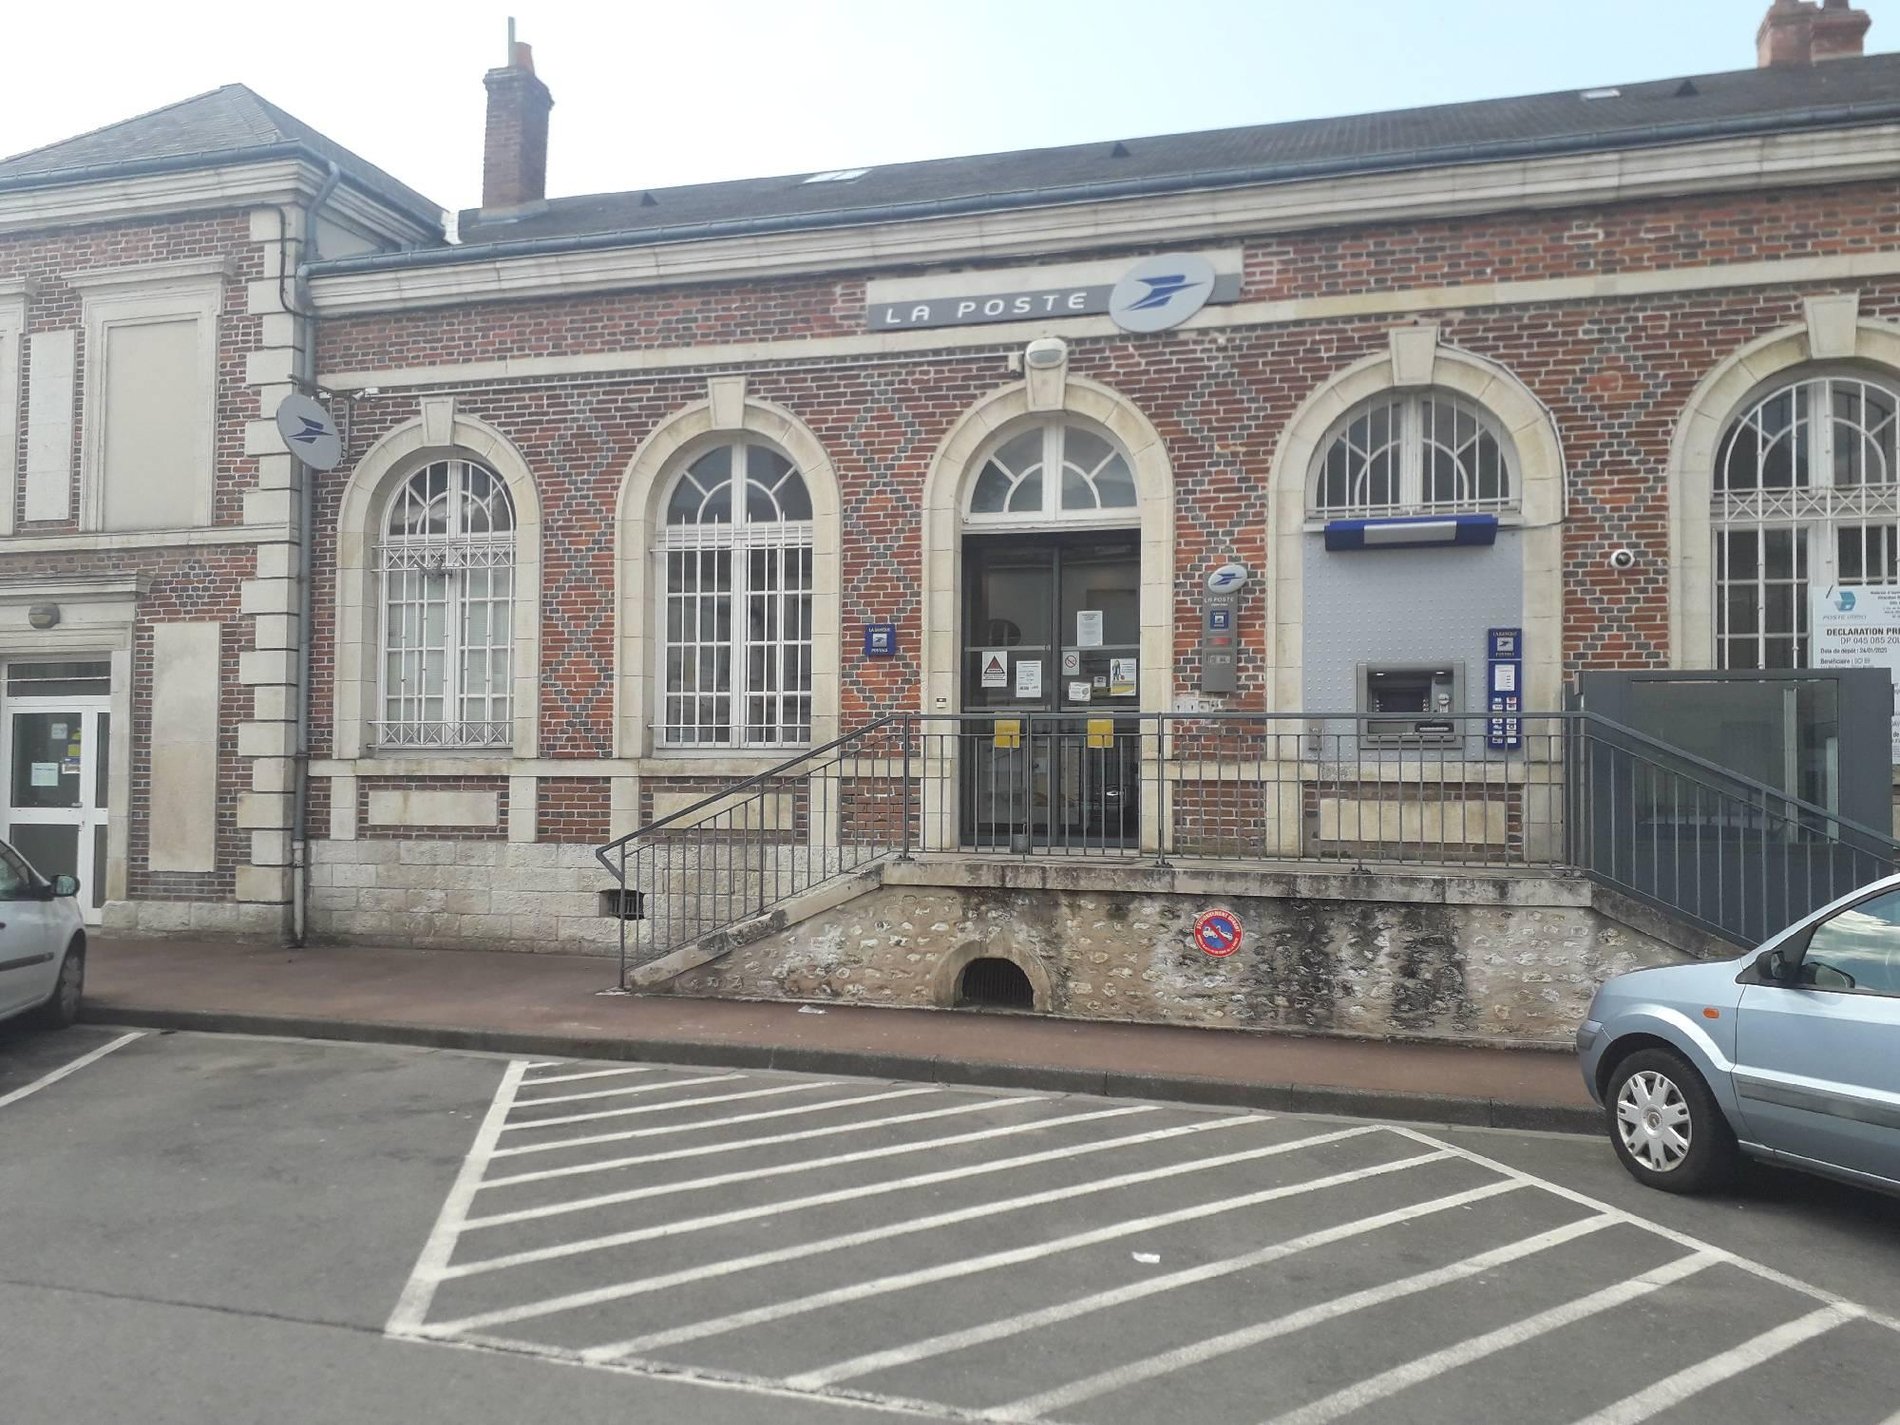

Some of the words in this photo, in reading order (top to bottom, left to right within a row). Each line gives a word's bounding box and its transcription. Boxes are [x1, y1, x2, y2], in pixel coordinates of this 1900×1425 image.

[885, 304, 930, 324] LA
[957, 291, 1088, 319] POSTE
[1840, 636, 1852, 645] DP
[1853, 636, 1868, 645] 045
